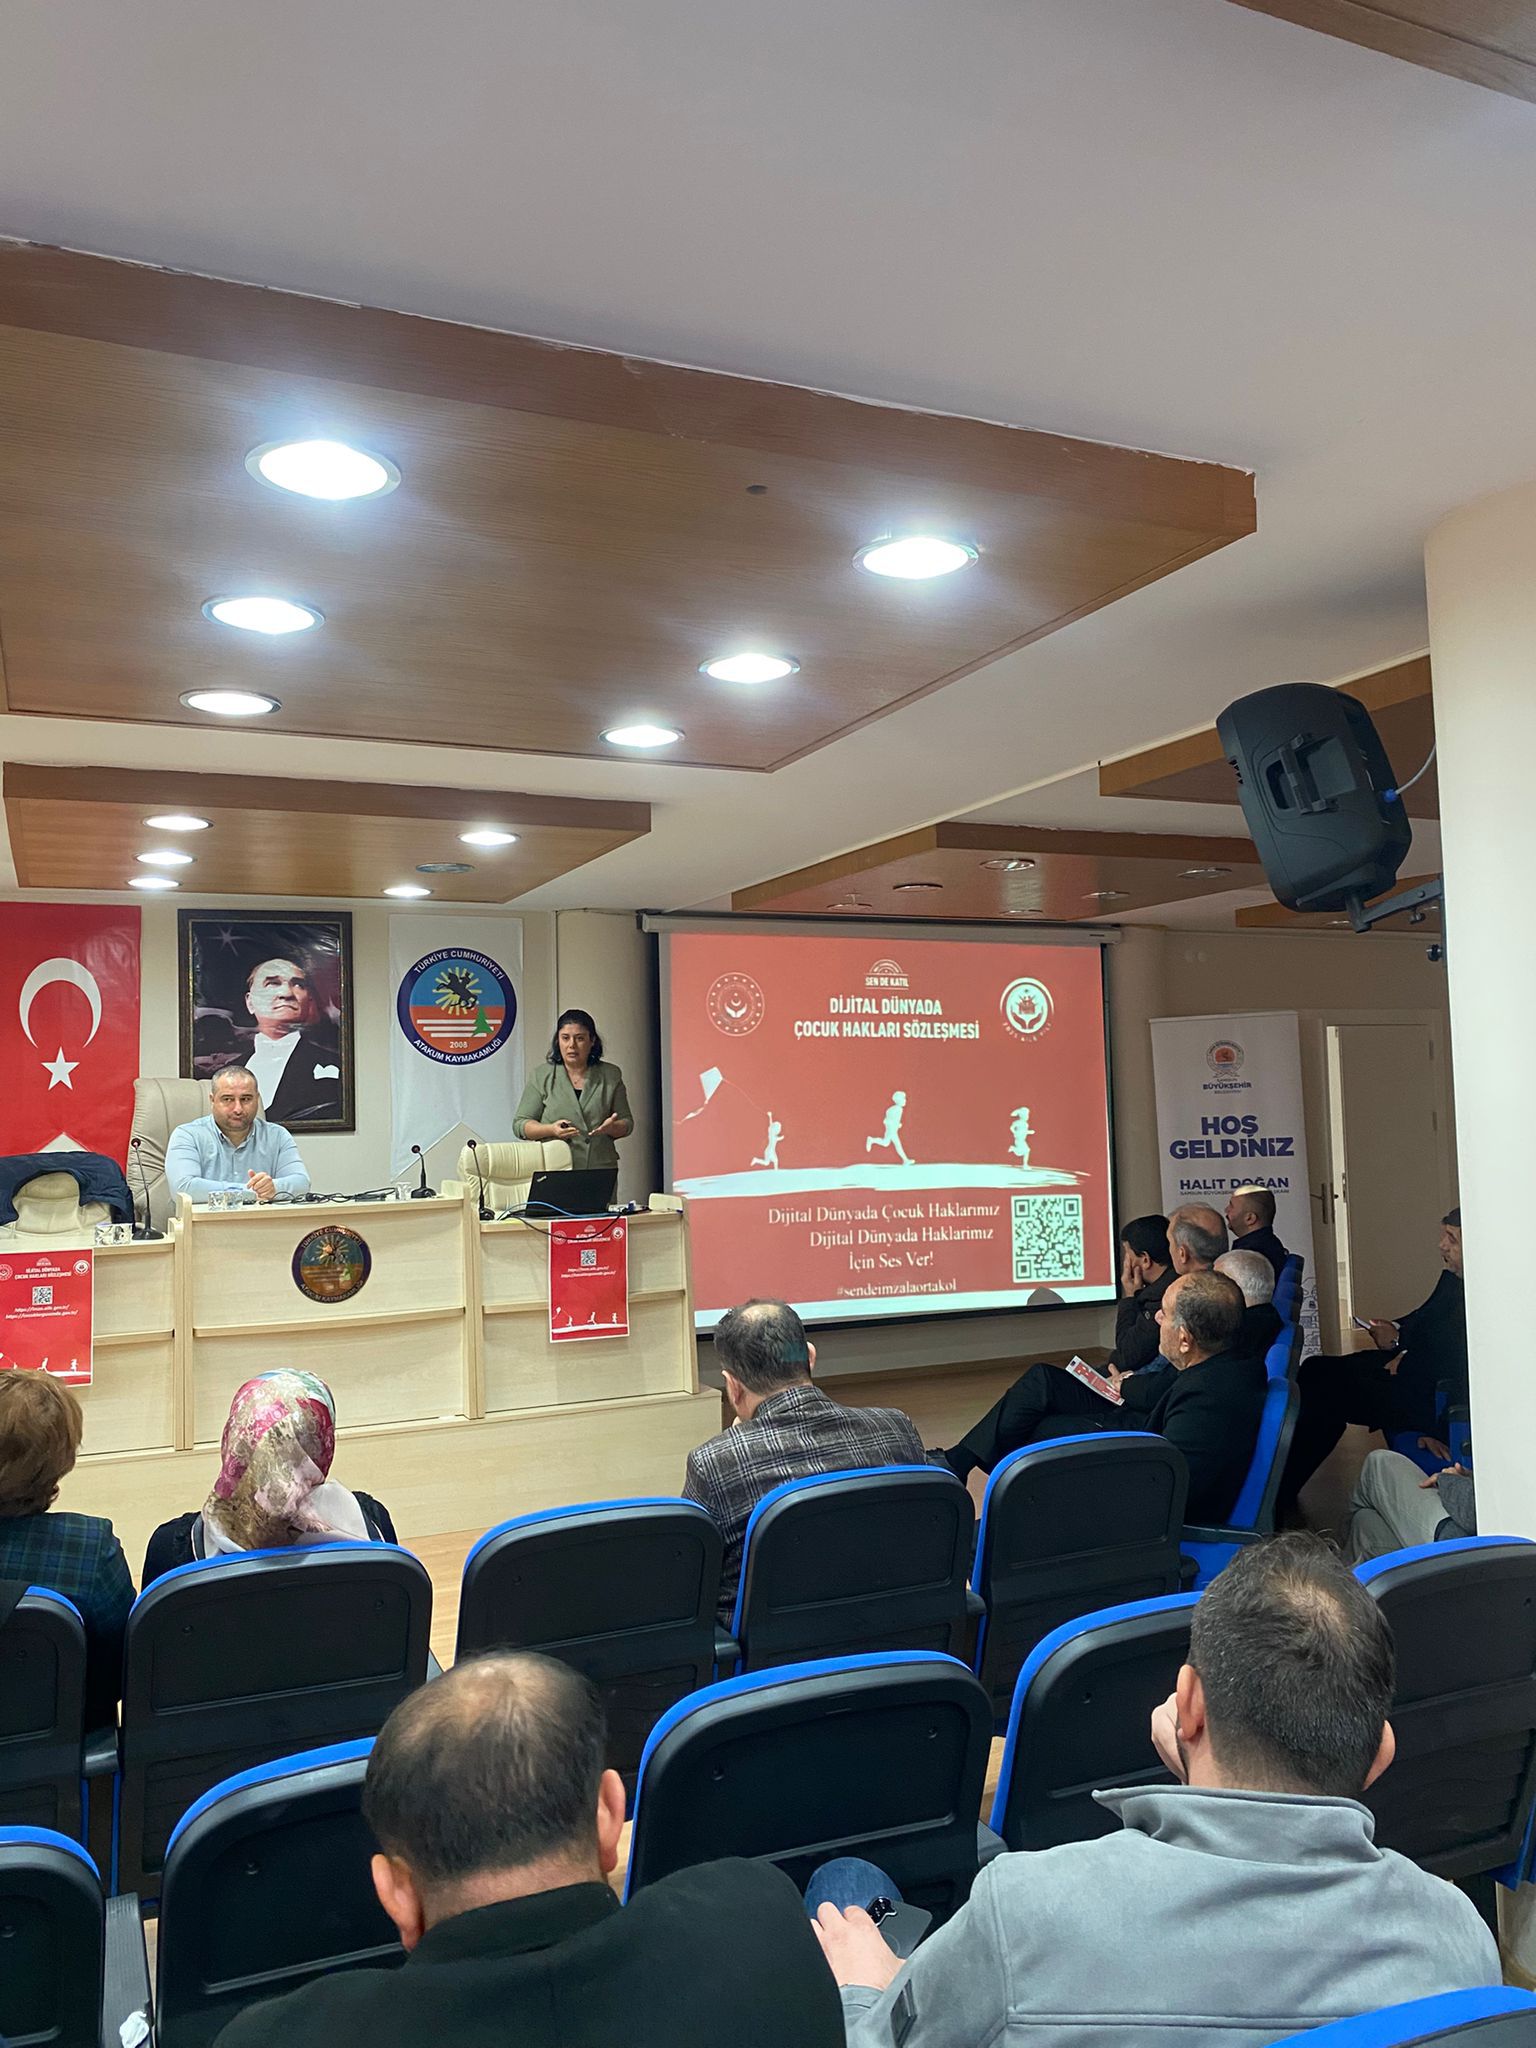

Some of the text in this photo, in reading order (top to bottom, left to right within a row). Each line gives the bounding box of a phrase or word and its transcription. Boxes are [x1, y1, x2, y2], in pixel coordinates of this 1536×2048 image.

[413, 949, 506, 981] TÜRKİYE CUMHURİYETİ
[865, 977, 909, 988] SEN DE KATIL
[829, 994, 943, 1016] DİJİTAL DÜNYADA
[794, 1019, 980, 1042] ÇOCUK HAKLARI SÖZLEŞMESİ
[413, 1038, 503, 1063] ATAKUM KAYMAKAMLIĞI
[449, 1041, 468, 1049] 2008
[1202, 1080, 1252, 1090] BÜYÜKŞEHİR
[1201, 1114, 1259, 1138] HOŞ
[1230, 1176, 1289, 1189] DOĞAN
[768, 1202, 1000, 1227] Dijital Dünyada Çocuk Haklarımız
[810, 1229, 853, 1250] Dijital
[857, 1227, 918, 1247] Dünyada
[849, 1251, 934, 1273] İçin Ses Ver!
